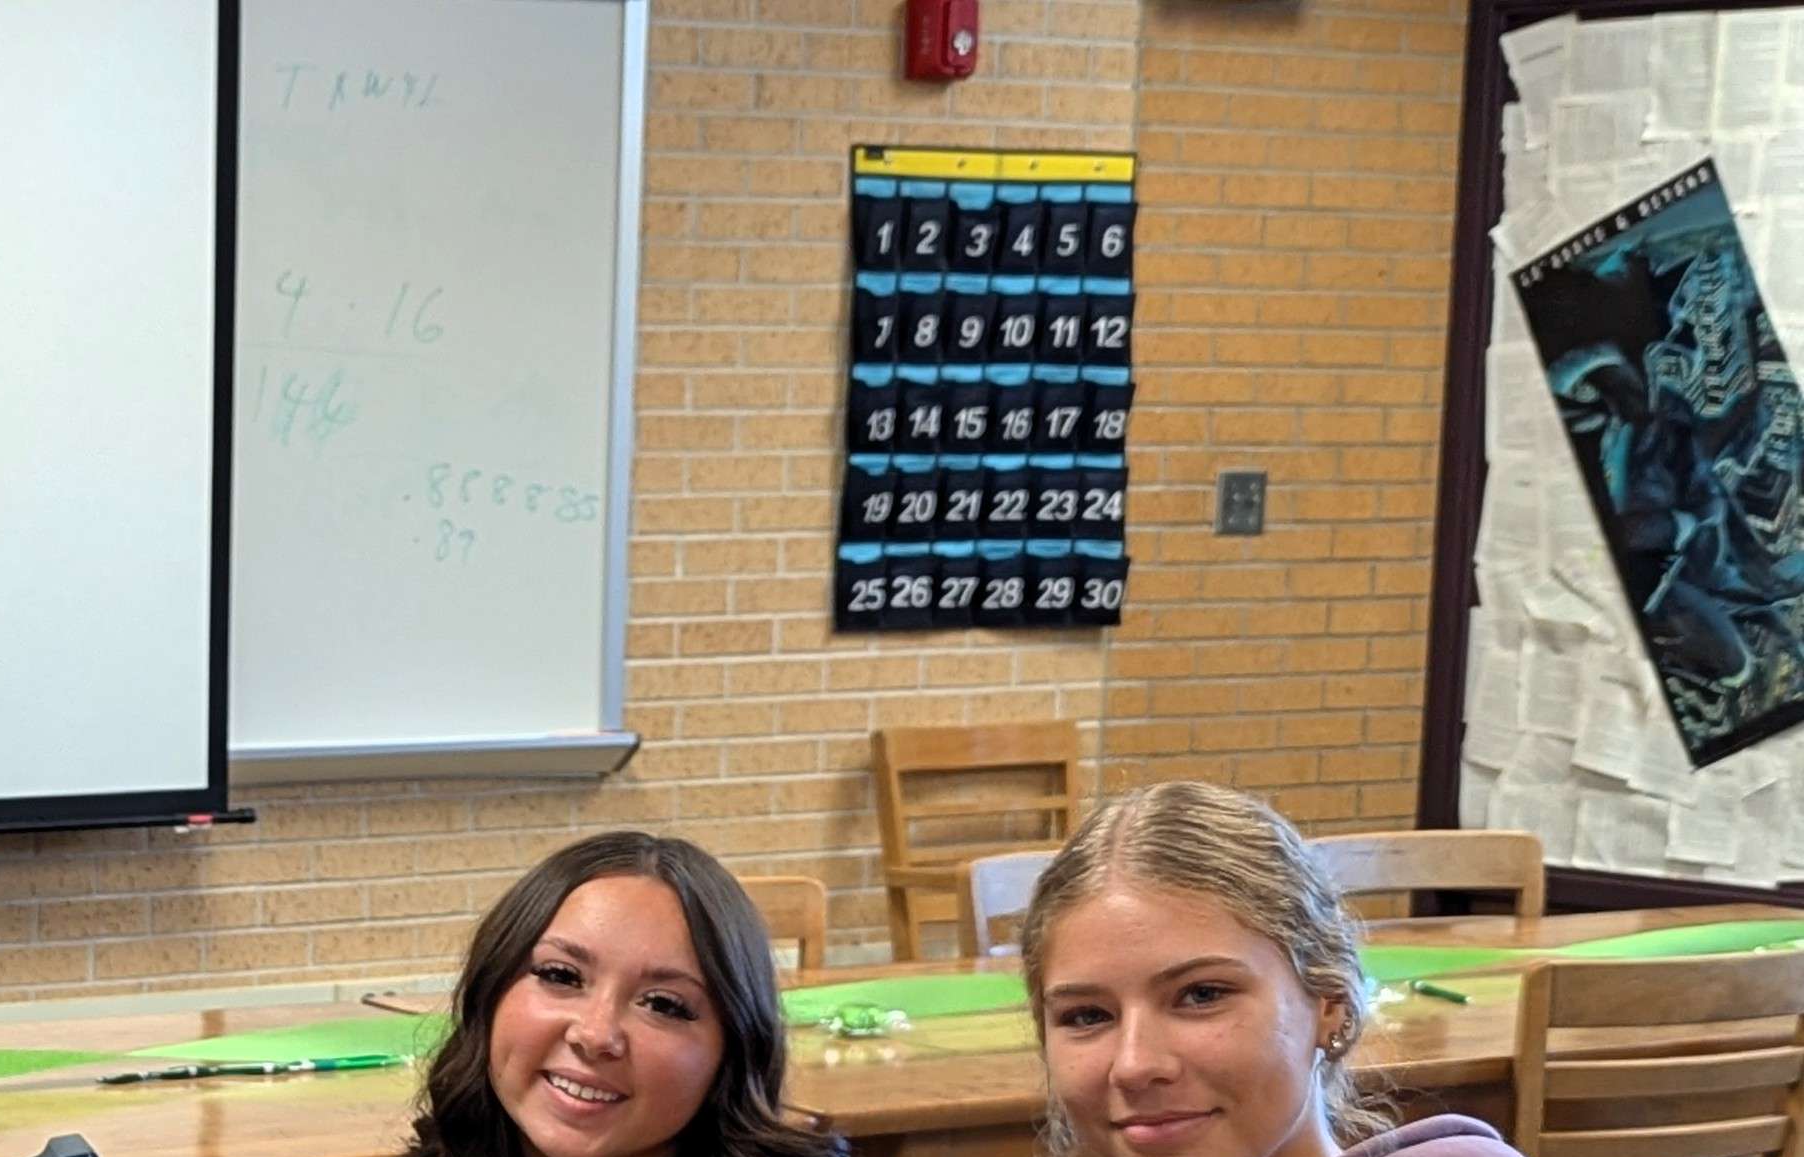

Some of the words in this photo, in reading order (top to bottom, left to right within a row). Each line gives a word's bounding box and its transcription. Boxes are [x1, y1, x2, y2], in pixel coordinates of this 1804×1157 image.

[876, 220, 894, 254] 1
[915, 220, 941, 254] 2
[965, 224, 992, 257] 3
[1012, 224, 1034, 256] 4
[1056, 224, 1081, 256] 5
[1101, 224, 1125, 258] 6
[874, 316, 894, 348] 7
[914, 314, 939, 347] 8
[959, 316, 985, 348] 9
[999, 314, 1035, 347] 10
[1049, 316, 1081, 347] 11
[1091, 317, 1128, 348] 12
[867, 408, 895, 441] 13
[908, 406, 942, 438] 14
[954, 406, 988, 439] 15
[1001, 407, 1034, 440] 16
[1046, 407, 1082, 438] 17
[1093, 409, 1126, 439] 18
[863, 491, 894, 523] 19
[898, 490, 937, 523] 20
[945, 490, 983, 521] 21
[989, 490, 1029, 521] 22
[1036, 490, 1079, 520] 23
[1082, 488, 1124, 521] 24
[848, 578, 887, 611] 25
[890, 576, 933, 607] 26
[939, 577, 979, 608] 27
[982, 577, 1025, 609] 28
[1035, 577, 1076, 608] 29
[1081, 578, 1123, 609] 30
